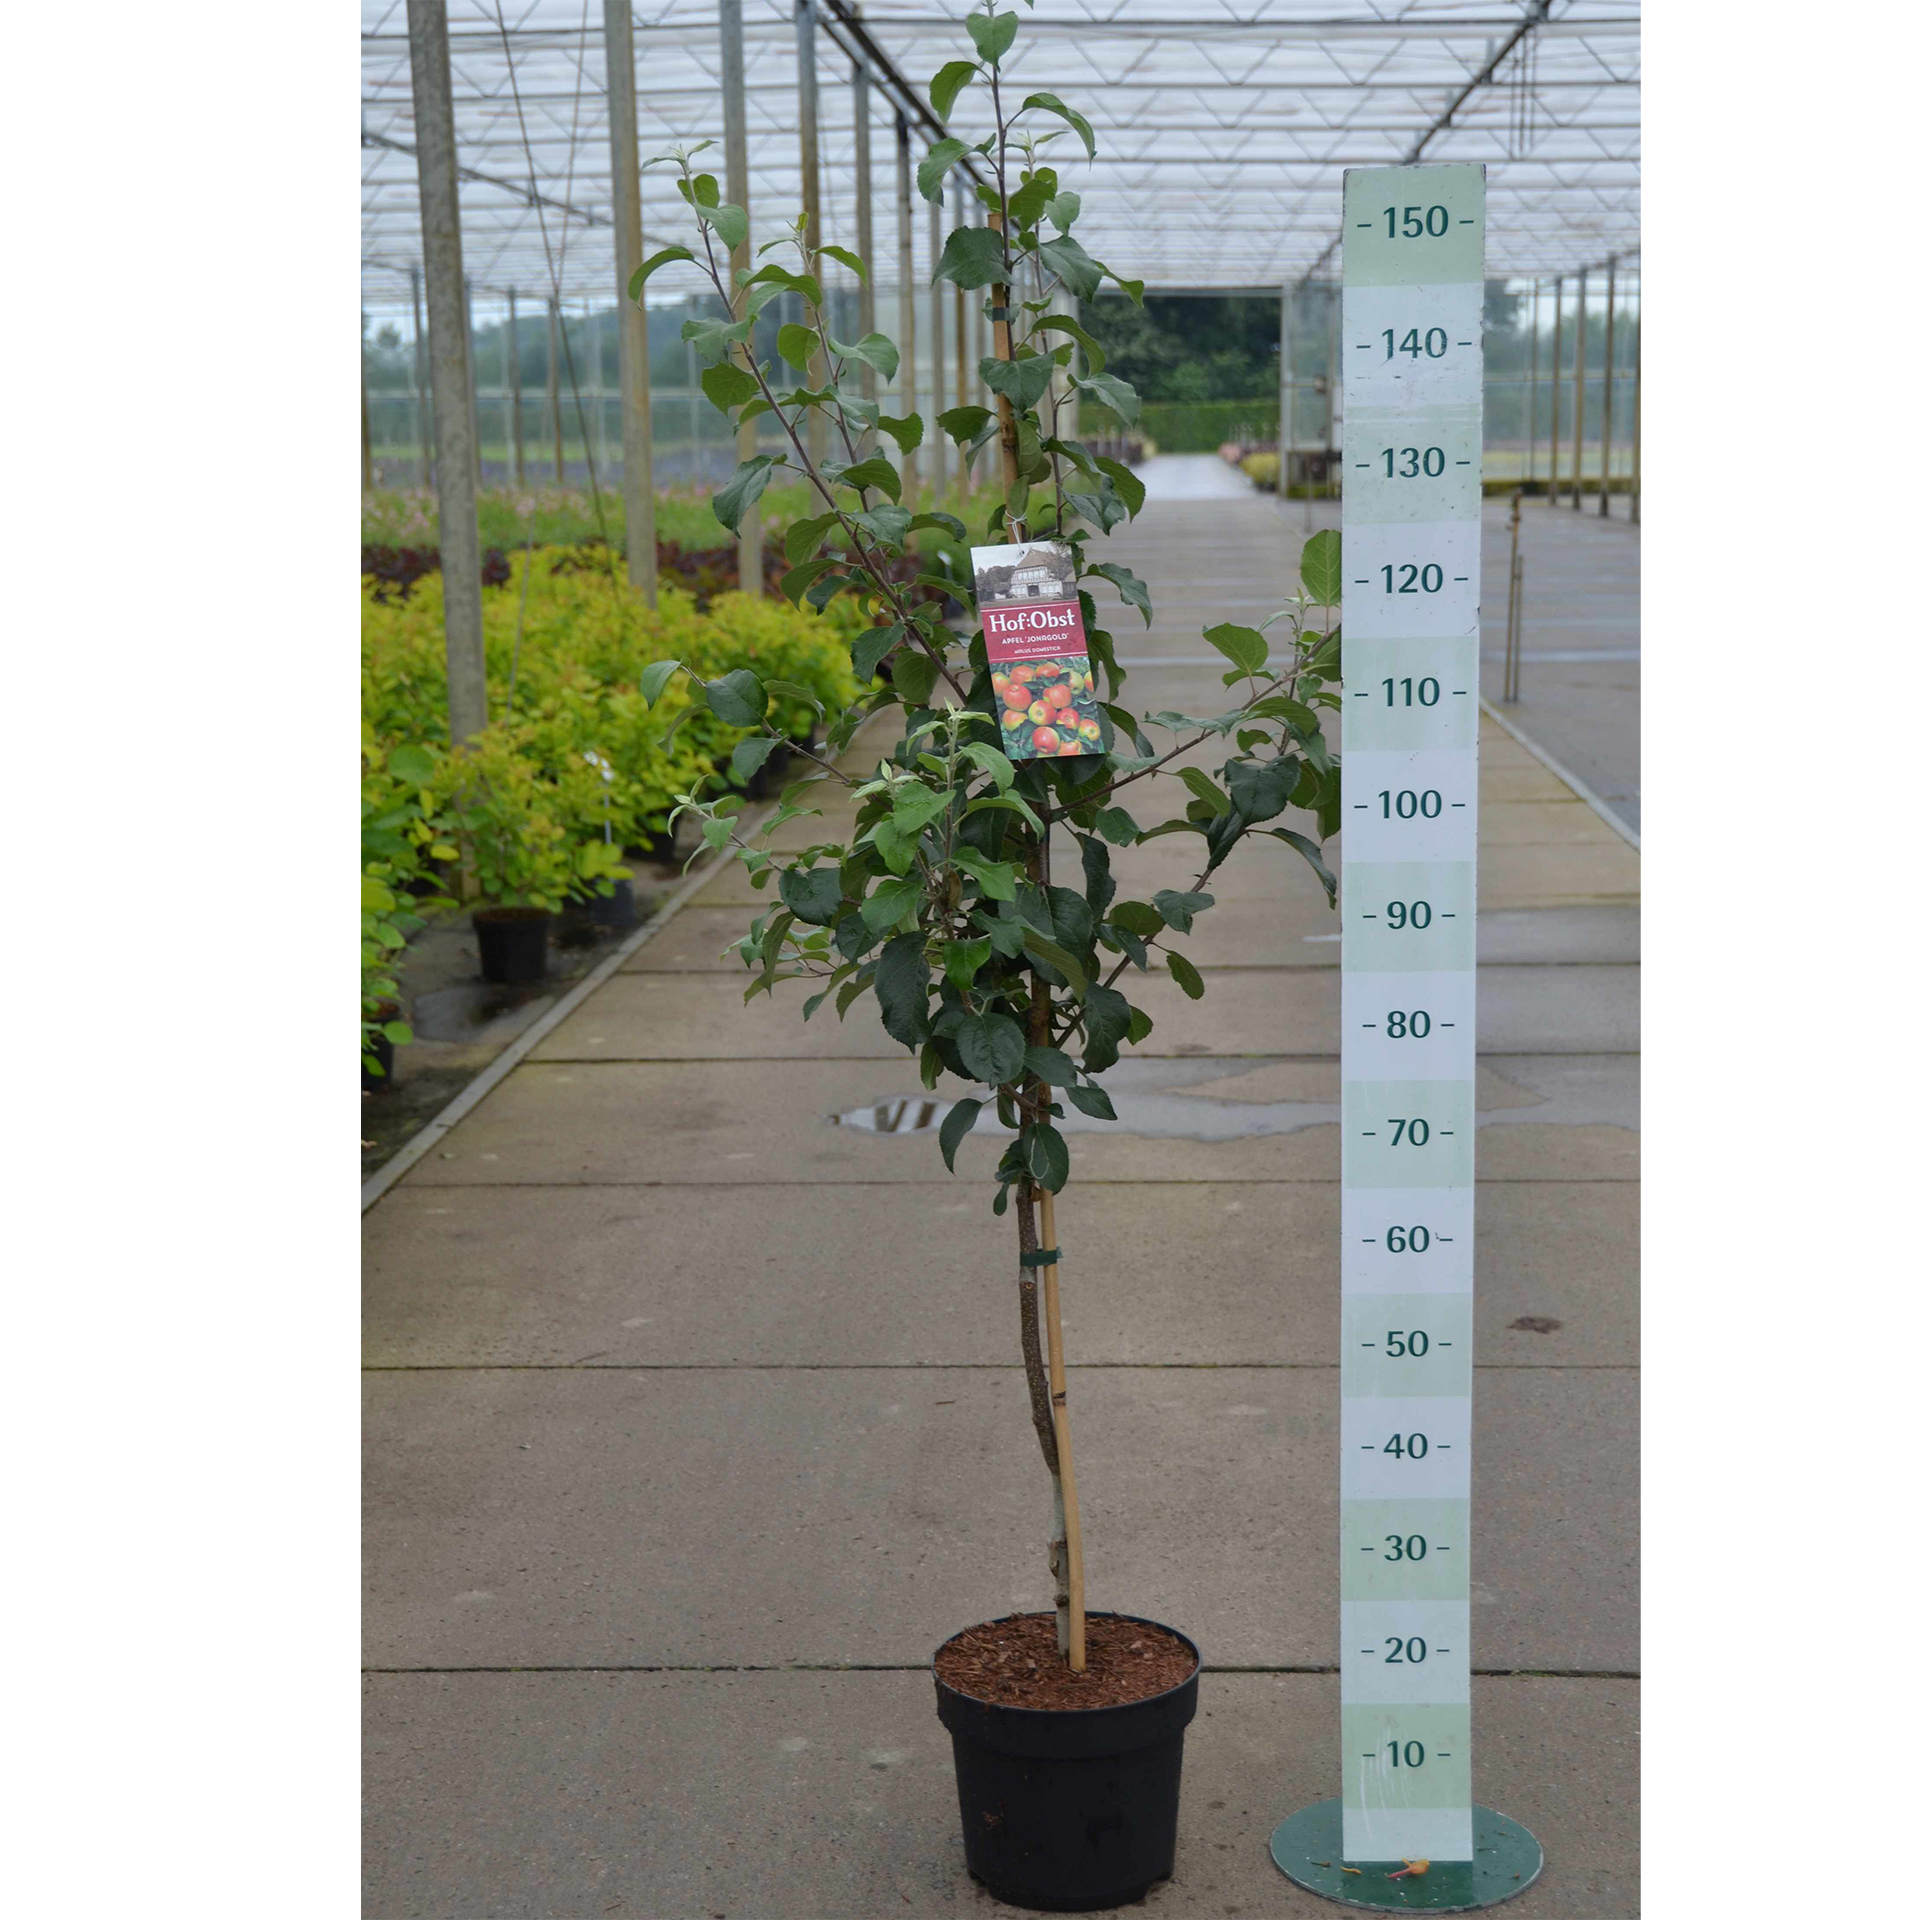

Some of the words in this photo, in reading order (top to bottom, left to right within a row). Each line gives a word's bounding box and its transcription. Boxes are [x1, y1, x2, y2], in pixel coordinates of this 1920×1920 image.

[1383, 205, 1449, 239] 150
[1382, 327, 1448, 360] 140
[1381, 446, 1446, 479] 130
[1381, 563, 1444, 594] 120
[1002, 636, 1024, 645] APFEL
[1381, 677, 1440, 707] 110
[1378, 789, 1442, 819] 100
[1386, 900, 1432, 930] 90
[1386, 1010, 1431, 1039] 80
[1387, 1118, 1430, 1147] 70
[1386, 1225, 1430, 1254] 60
[1385, 1330, 1429, 1358] 50
[1383, 1432, 1428, 1460] 40
[1384, 1534, 1427, 1562] 30
[1384, 1636, 1427, 1664] 20
[1387, 1740, 1425, 1768] 10
